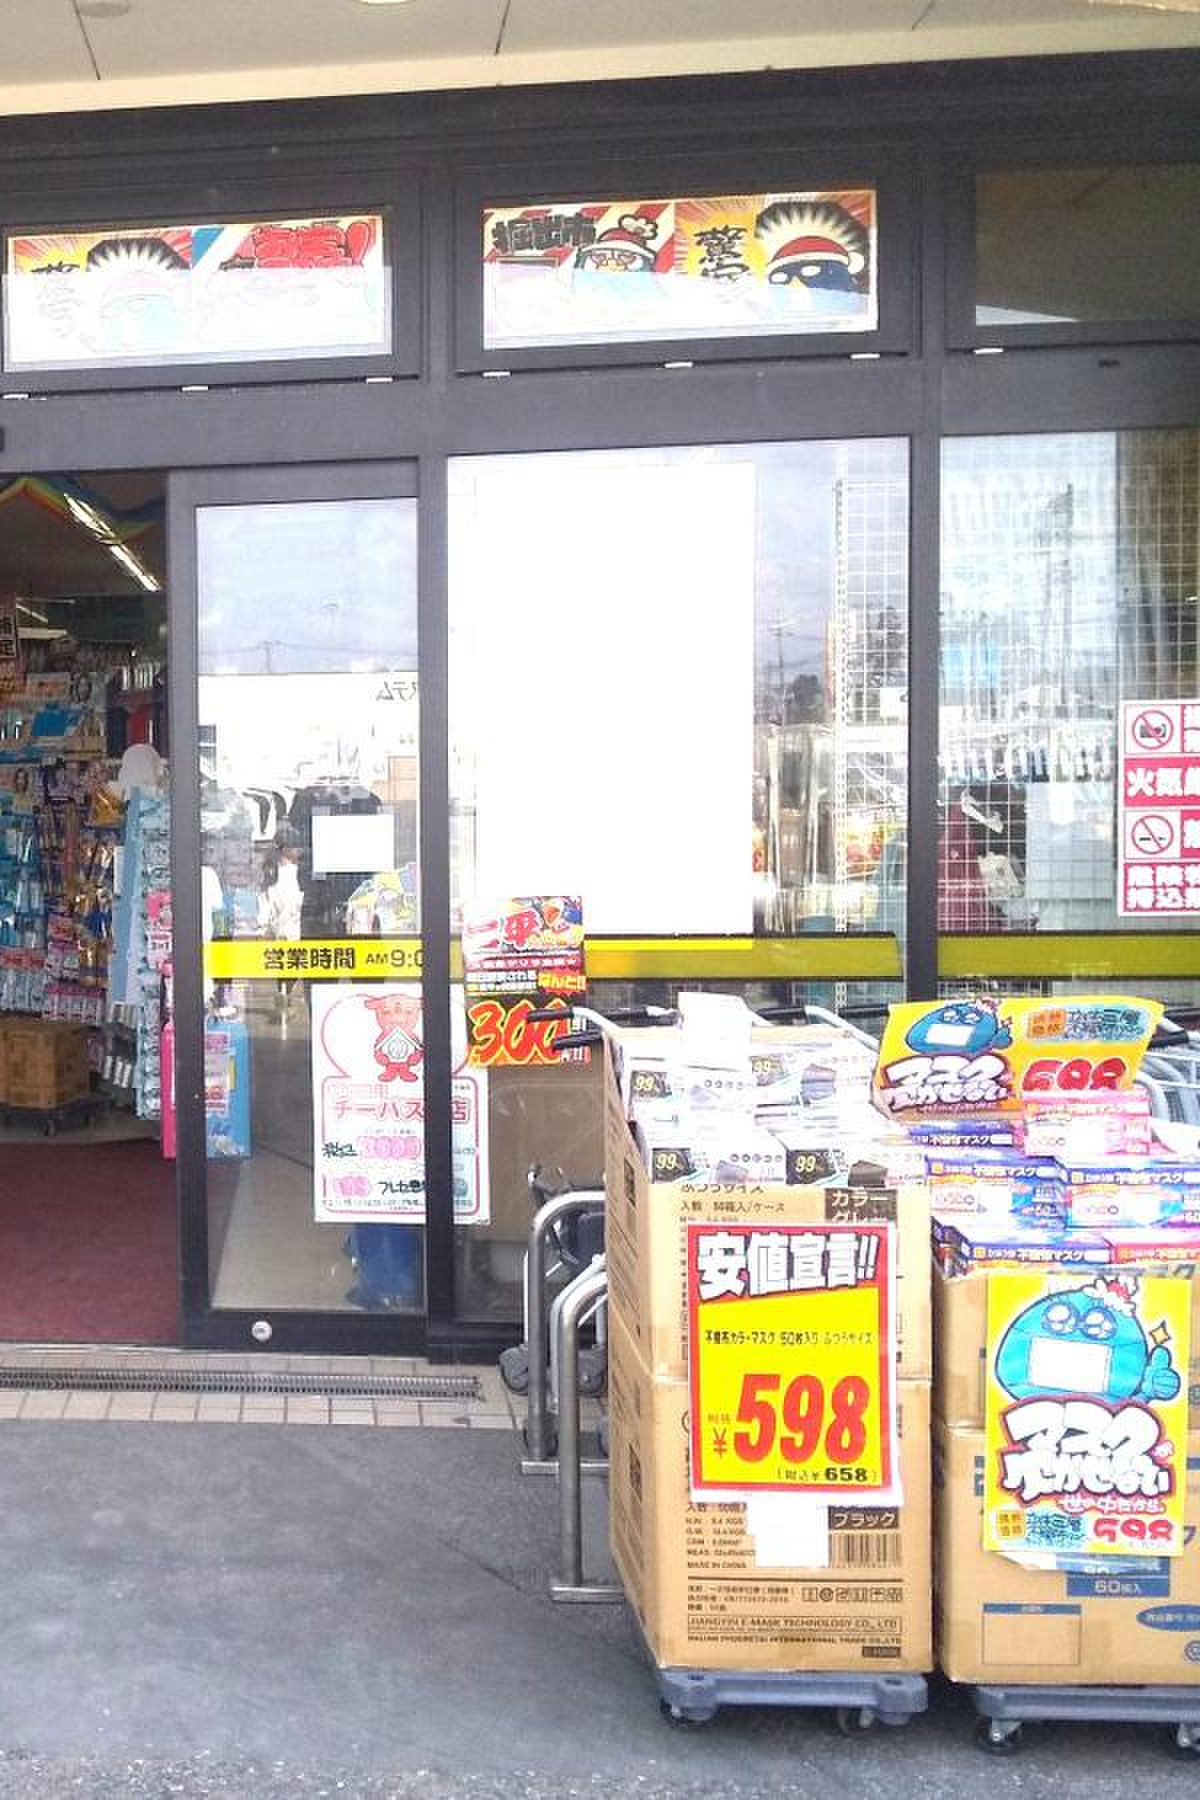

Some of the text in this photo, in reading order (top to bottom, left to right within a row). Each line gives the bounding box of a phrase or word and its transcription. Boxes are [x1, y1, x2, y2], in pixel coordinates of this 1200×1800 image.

[263, 948, 357, 970] 営業時間
[834, 1511, 896, 1528] ブラック
